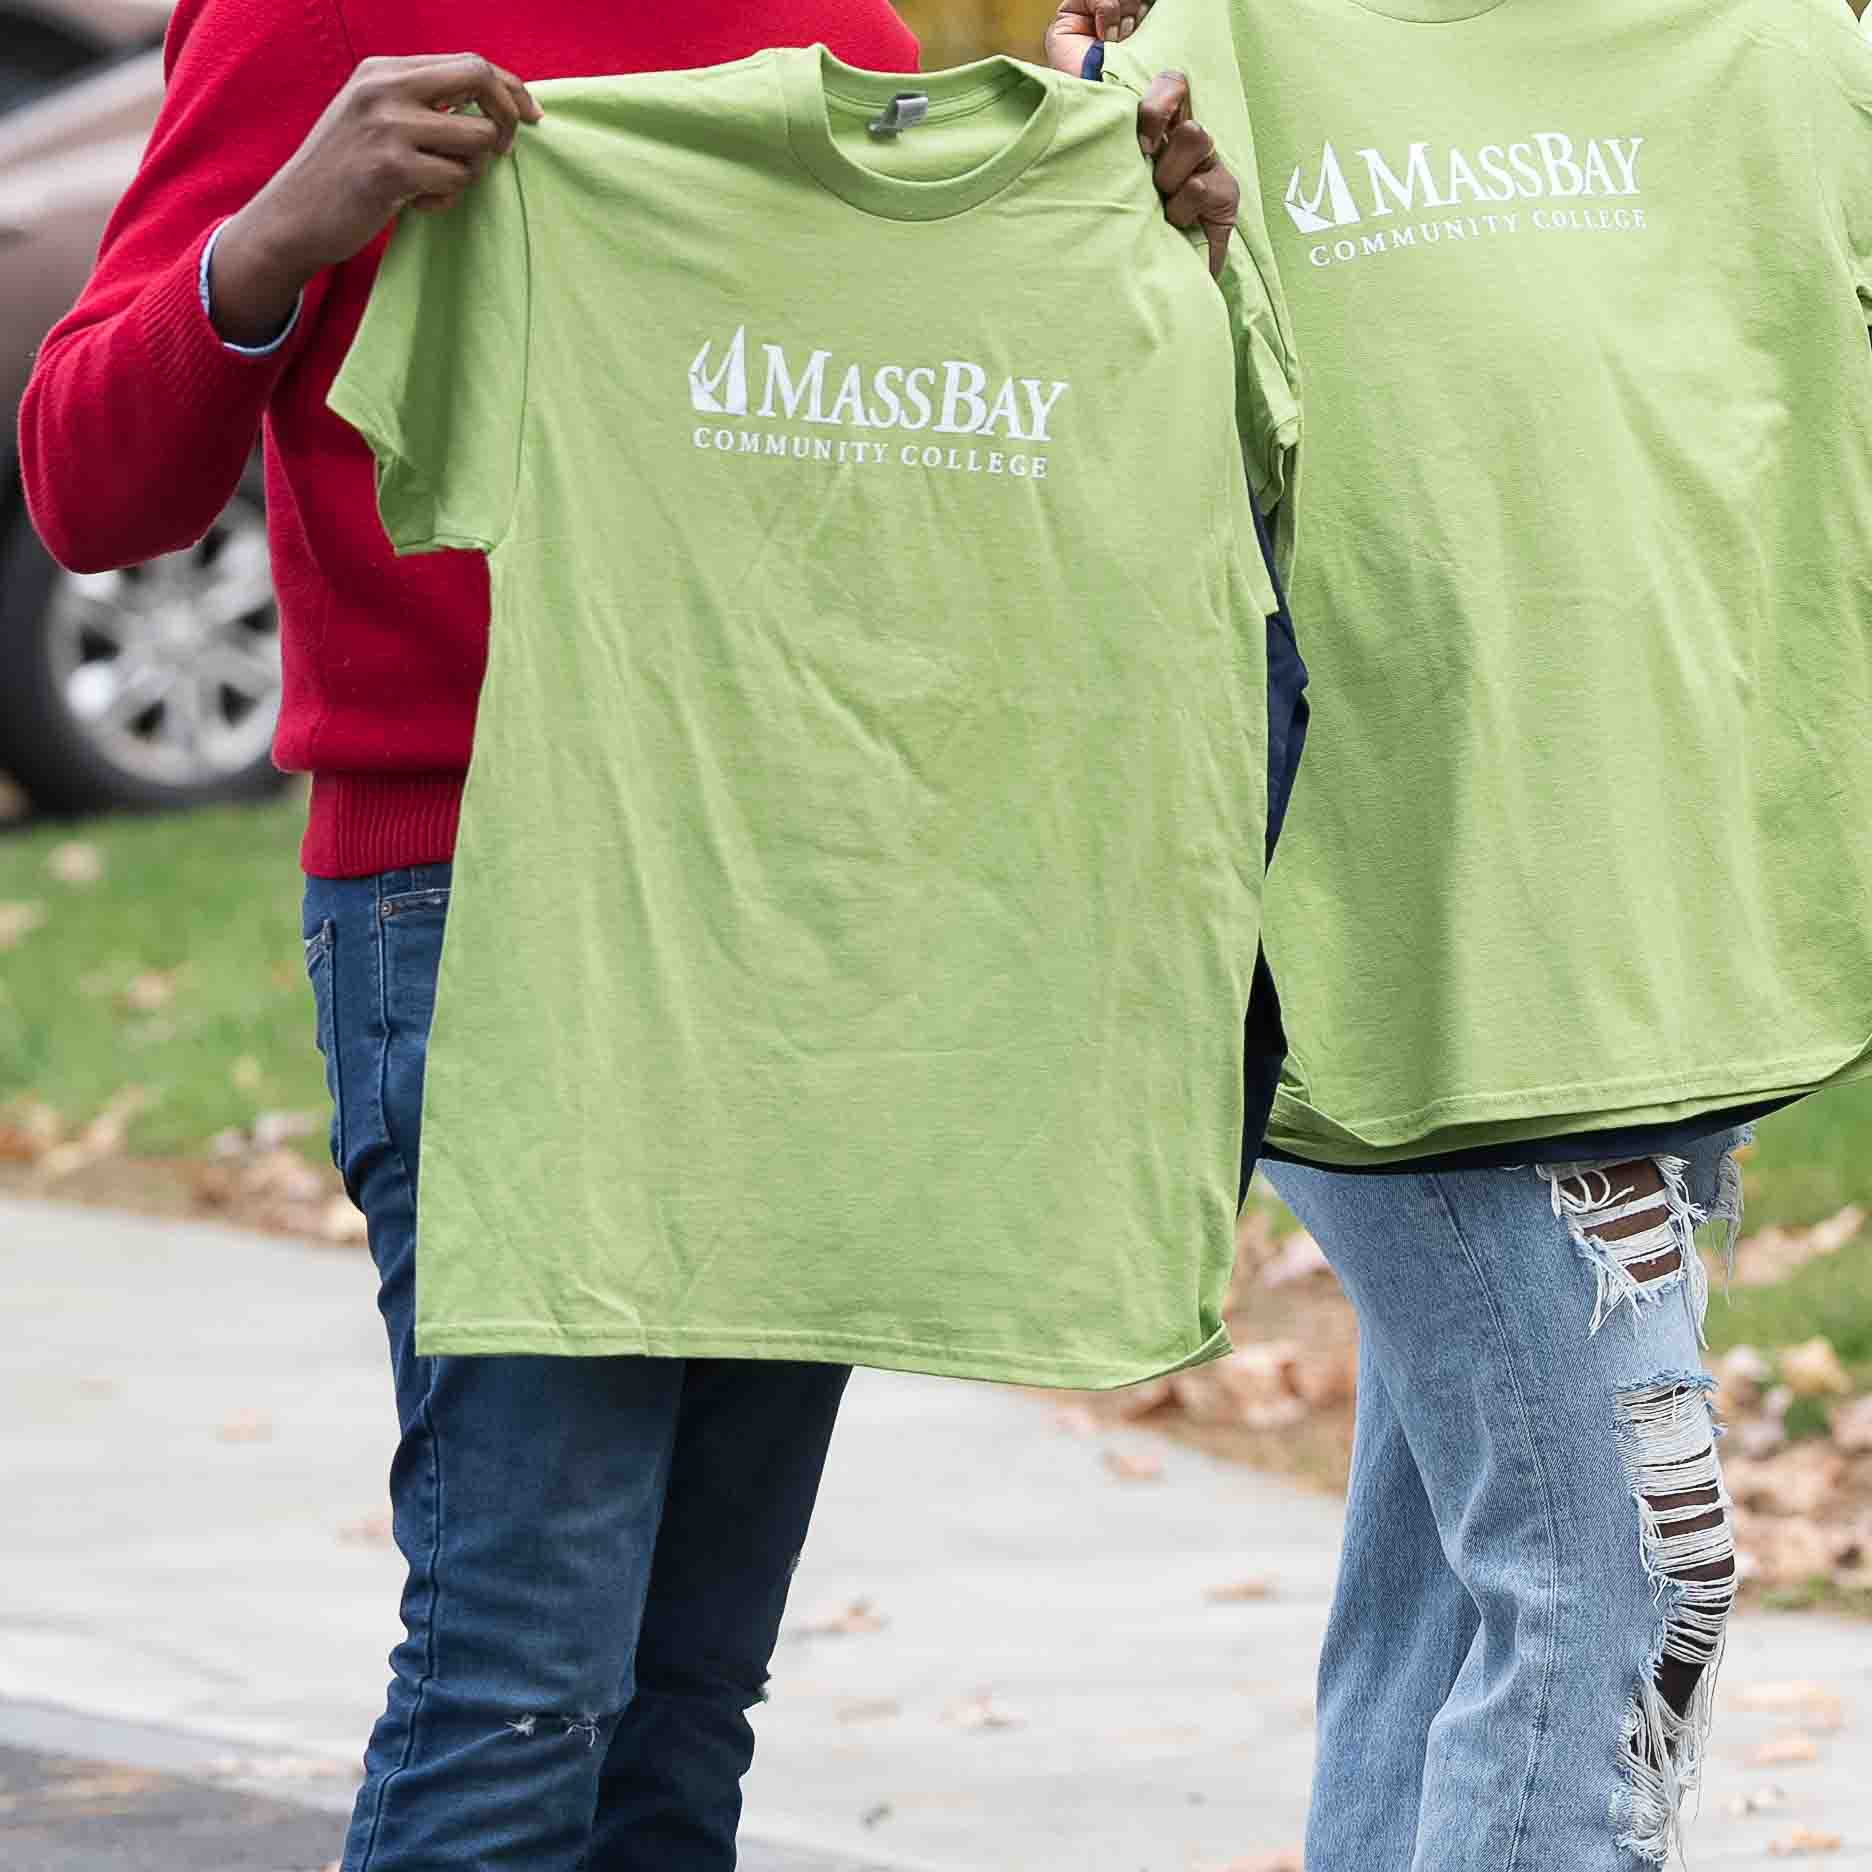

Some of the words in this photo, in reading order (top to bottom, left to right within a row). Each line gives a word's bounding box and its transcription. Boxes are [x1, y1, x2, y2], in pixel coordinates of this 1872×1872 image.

[1309, 213, 1519, 267] COMMUNITY
[1533, 209, 1647, 230] COLLEGE
[693, 427, 888, 465] COMMUNITY
[901, 445, 1049, 479] COLLEGE
